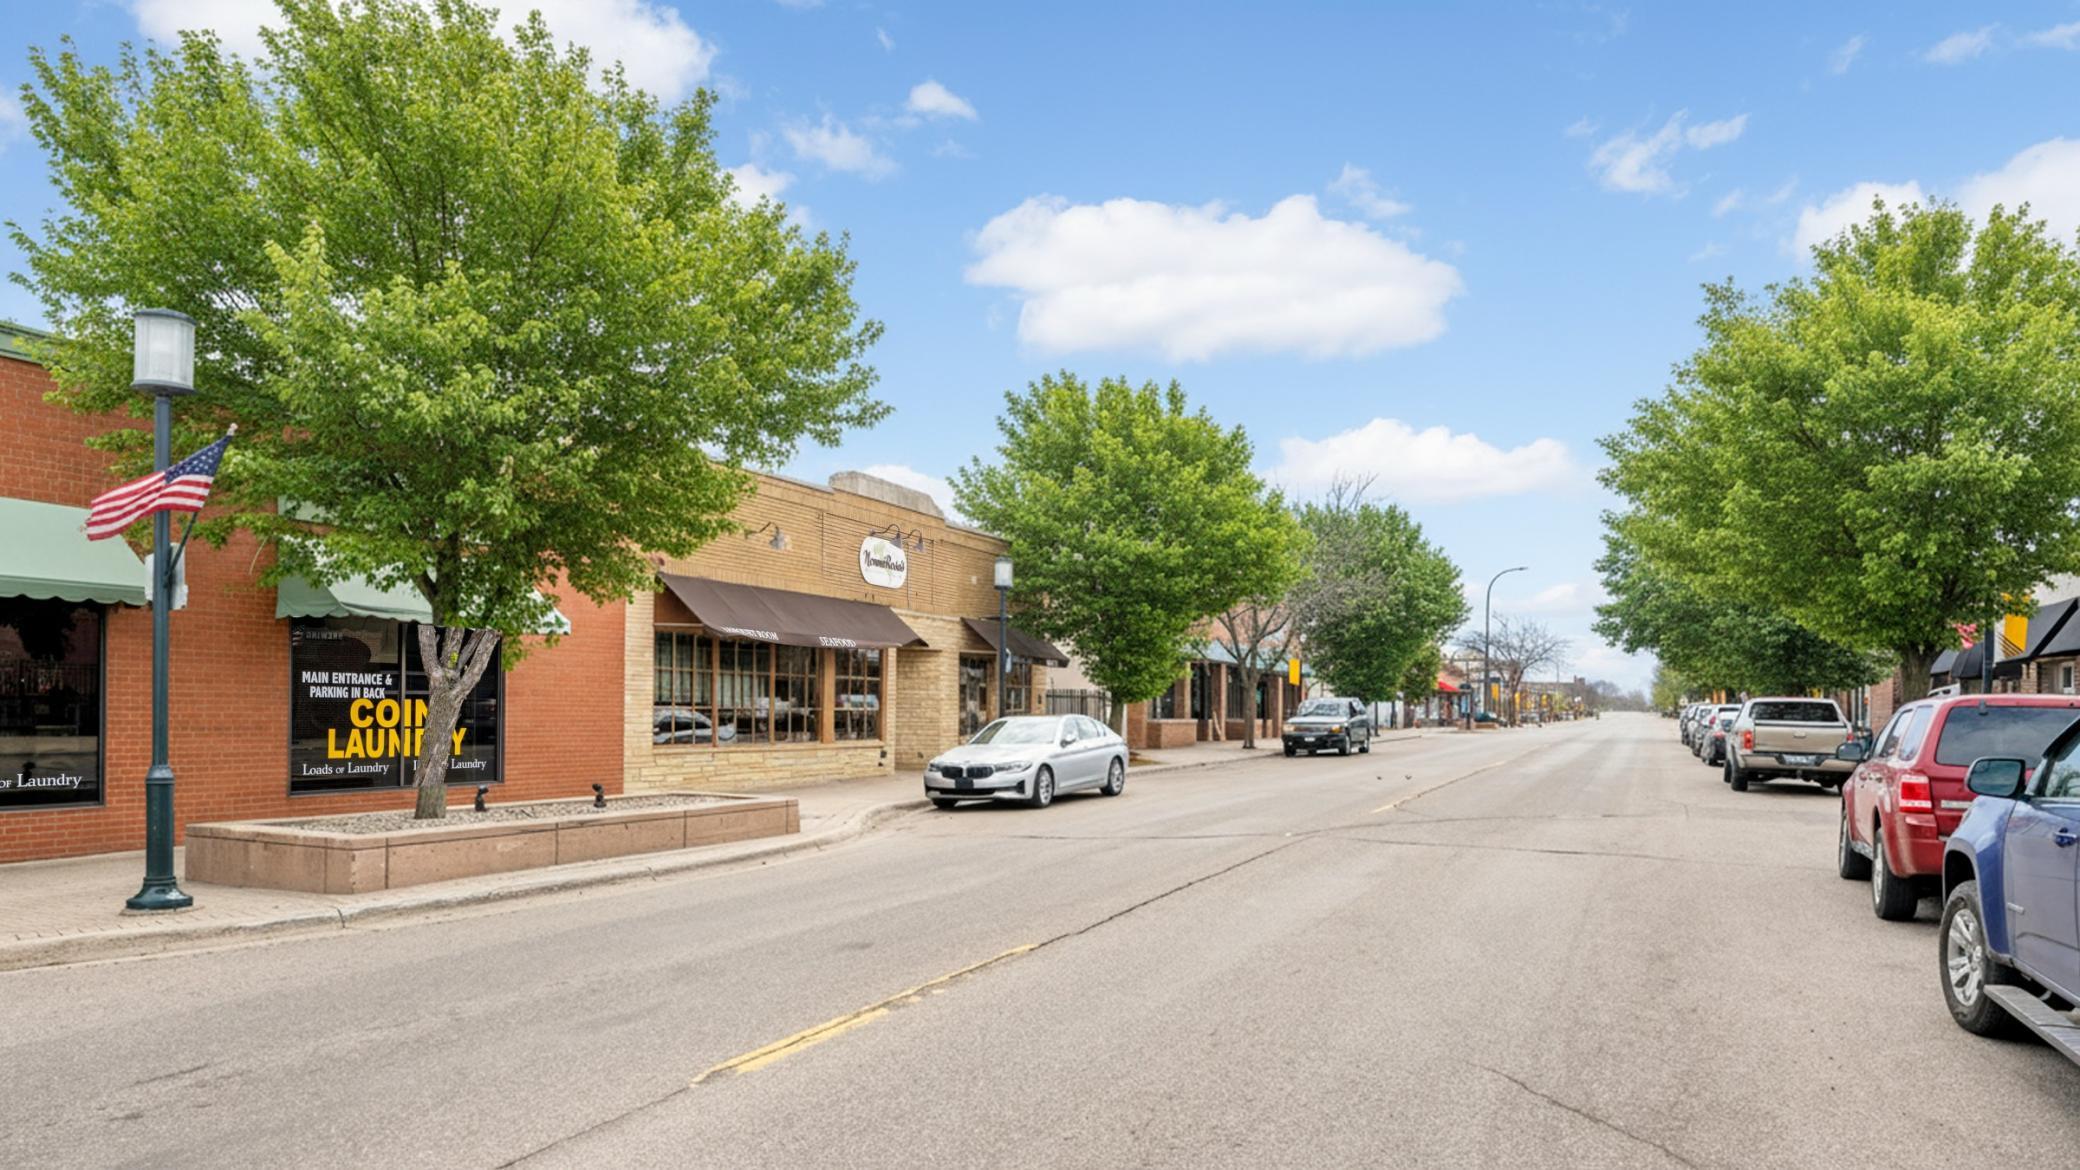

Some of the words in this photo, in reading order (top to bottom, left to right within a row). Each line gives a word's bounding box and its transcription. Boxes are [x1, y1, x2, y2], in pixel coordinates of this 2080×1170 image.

[818, 636, 857, 647] SEAFOOD
[302, 671, 329, 683] MAIN
[332, 672, 382, 685] ENTRANCE
[384, 673, 392, 686] &
[309, 686, 349, 698] PARKING
[351, 687, 361, 698] IN
[363, 687, 386, 699] BACK
[327, 728, 467, 758] LAUNY
[302, 763, 332, 776] Loads
[347, 762, 389, 775] Laundry
[451, 758, 486, 771] Laundry
[16, 773, 82, 789] Laundry
